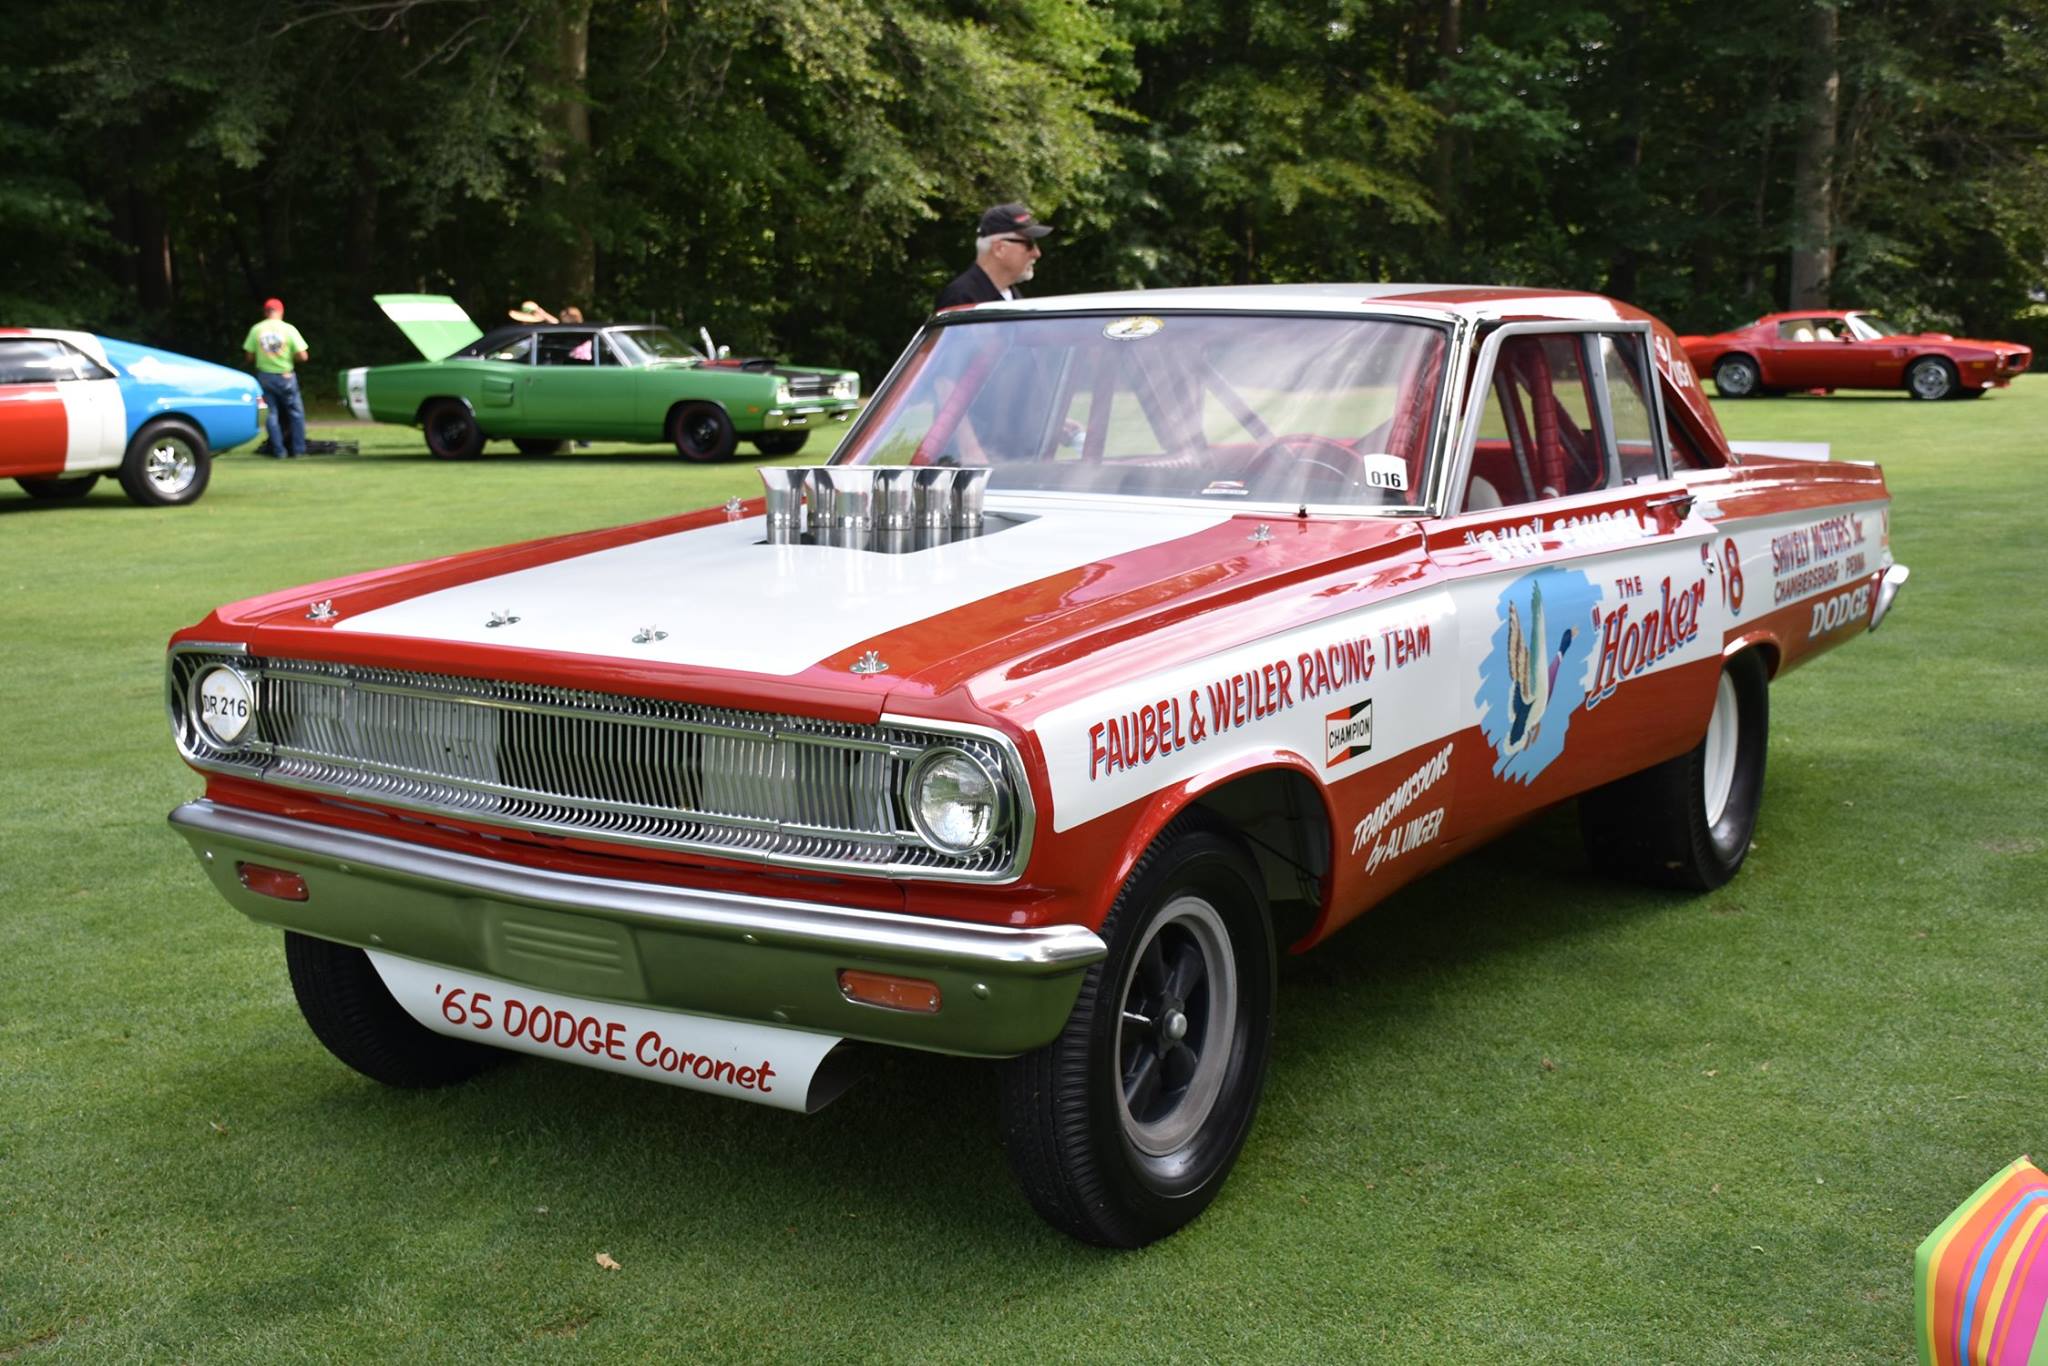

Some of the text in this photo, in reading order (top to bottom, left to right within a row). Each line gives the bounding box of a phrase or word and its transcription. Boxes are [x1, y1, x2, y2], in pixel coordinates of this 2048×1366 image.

[1371, 471, 1401, 488] 016
[1811, 515, 1851, 557] MOTORS
[1616, 575, 1643, 599] THE
[1775, 561, 1839, 605] CHAMBERSBURG
[1808, 583, 1871, 640] DODGE
[203, 694, 248, 718] DR 216
[1088, 622, 1431, 781] FAUBEL & WEILER RACING TEAM
[1329, 717, 1370, 749] CHAMPION
[1351, 742, 1454, 856] TRANSMISSIONS
[435, 984, 777, 1093] '65 DODGE Coronet
